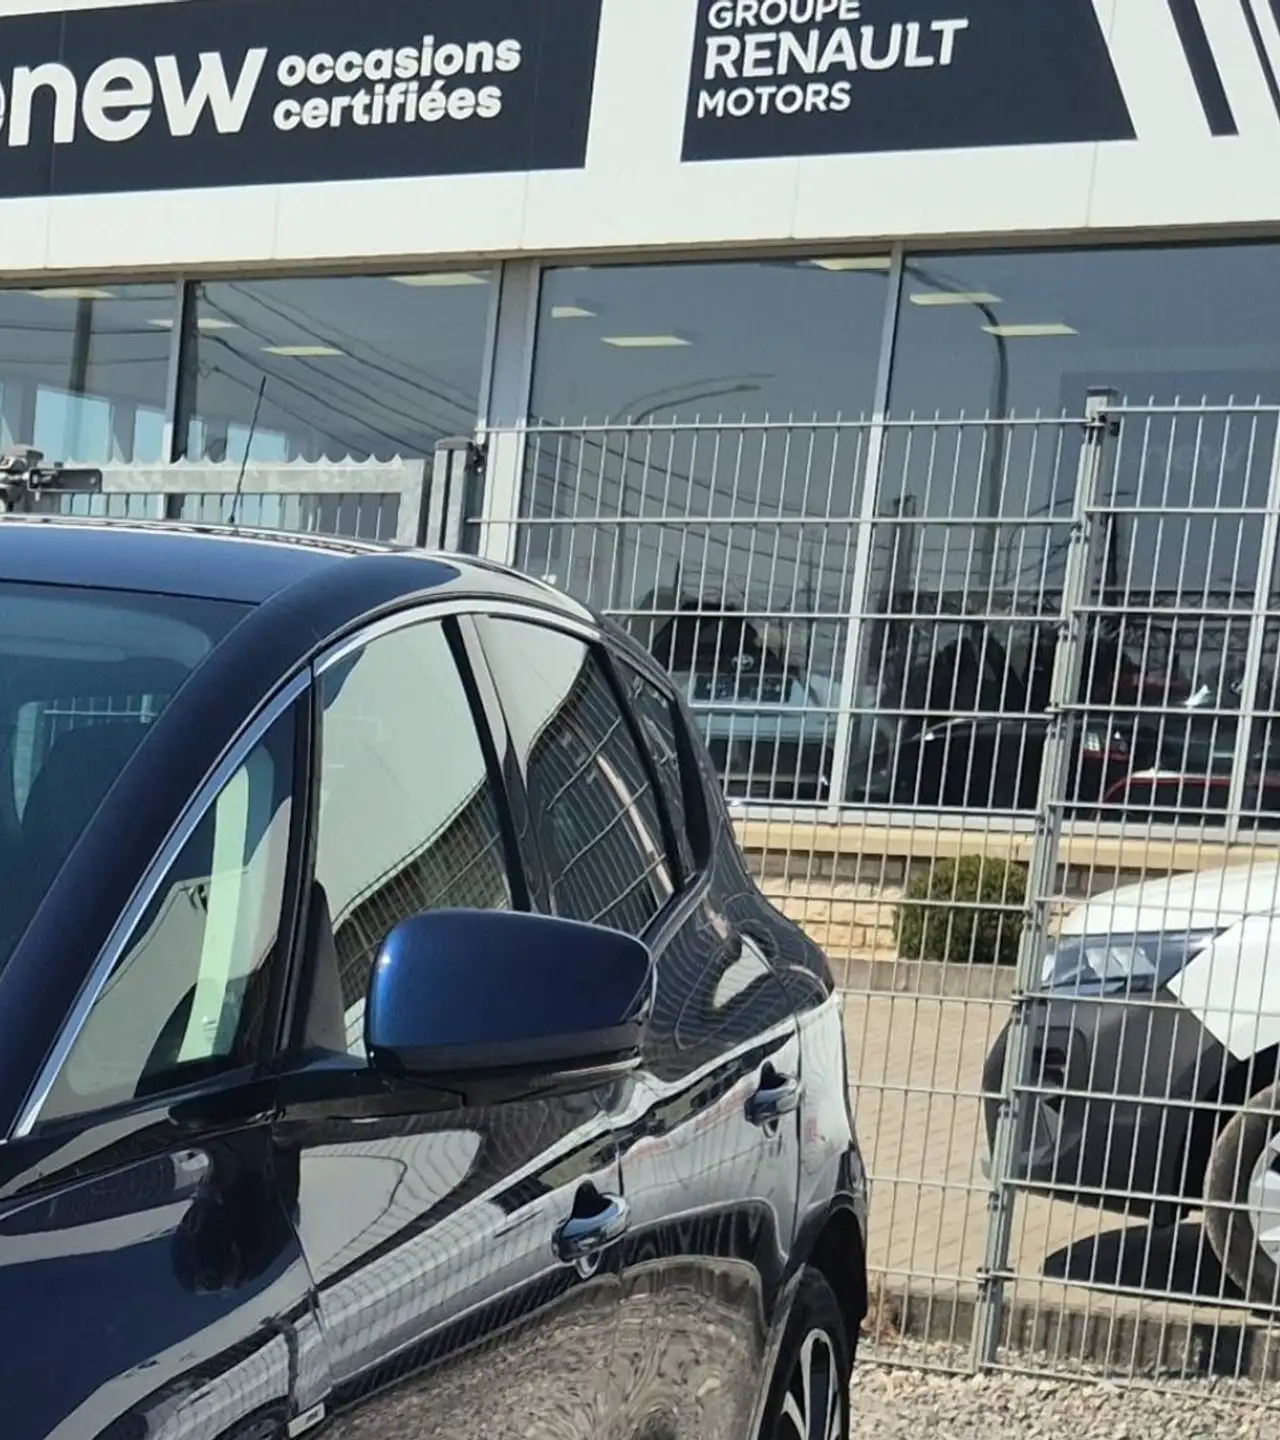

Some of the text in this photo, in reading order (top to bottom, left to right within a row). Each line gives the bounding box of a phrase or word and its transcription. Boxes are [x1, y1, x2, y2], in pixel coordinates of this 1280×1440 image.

[708, 0, 861, 30] GROUPE
[276, 35, 522, 87] occasions
[703, 17, 969, 80] RENAULT
[272, 80, 503, 131] certifiées
[696, 80, 852, 119] MOTORS
